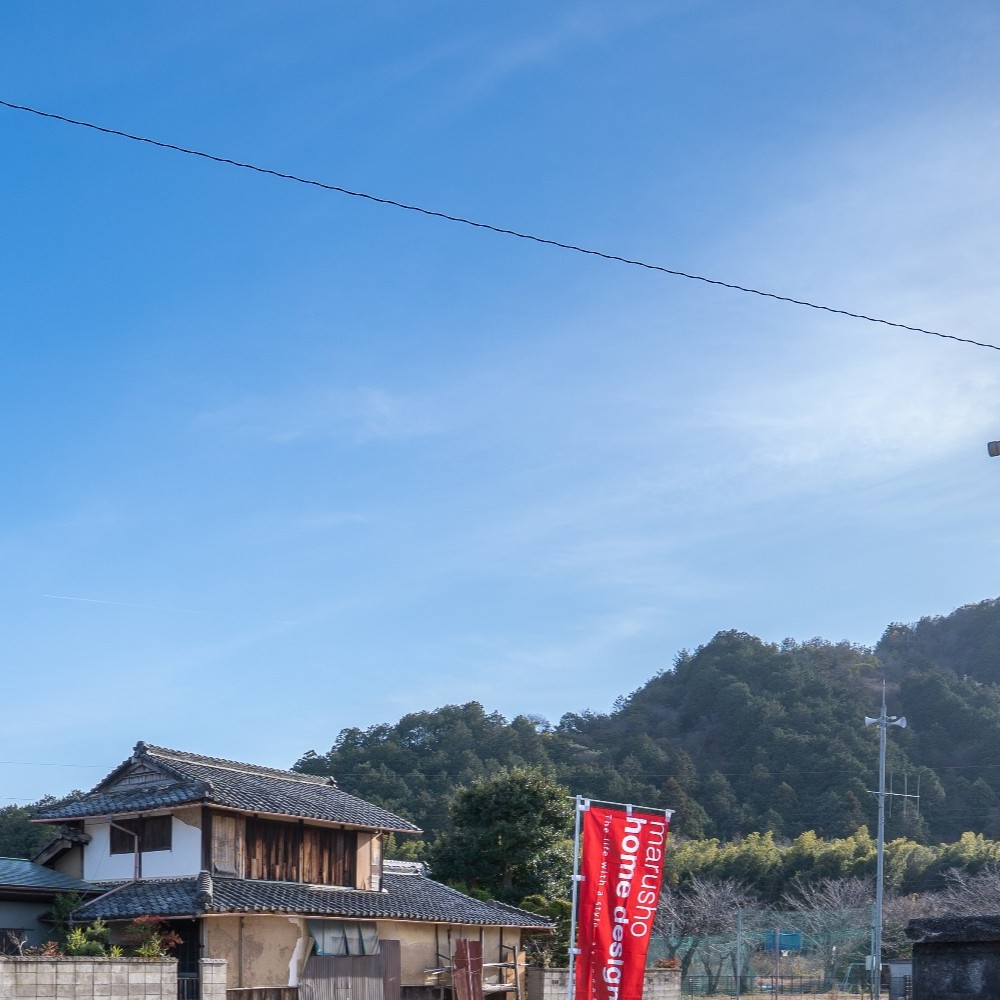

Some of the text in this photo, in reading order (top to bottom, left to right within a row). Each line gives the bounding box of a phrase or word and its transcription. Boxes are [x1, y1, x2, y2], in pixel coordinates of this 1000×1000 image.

[604, 814, 612, 833] The
[599, 861, 608, 886] with
[616, 816, 647, 898] home
[630, 821, 665, 937] marusho
